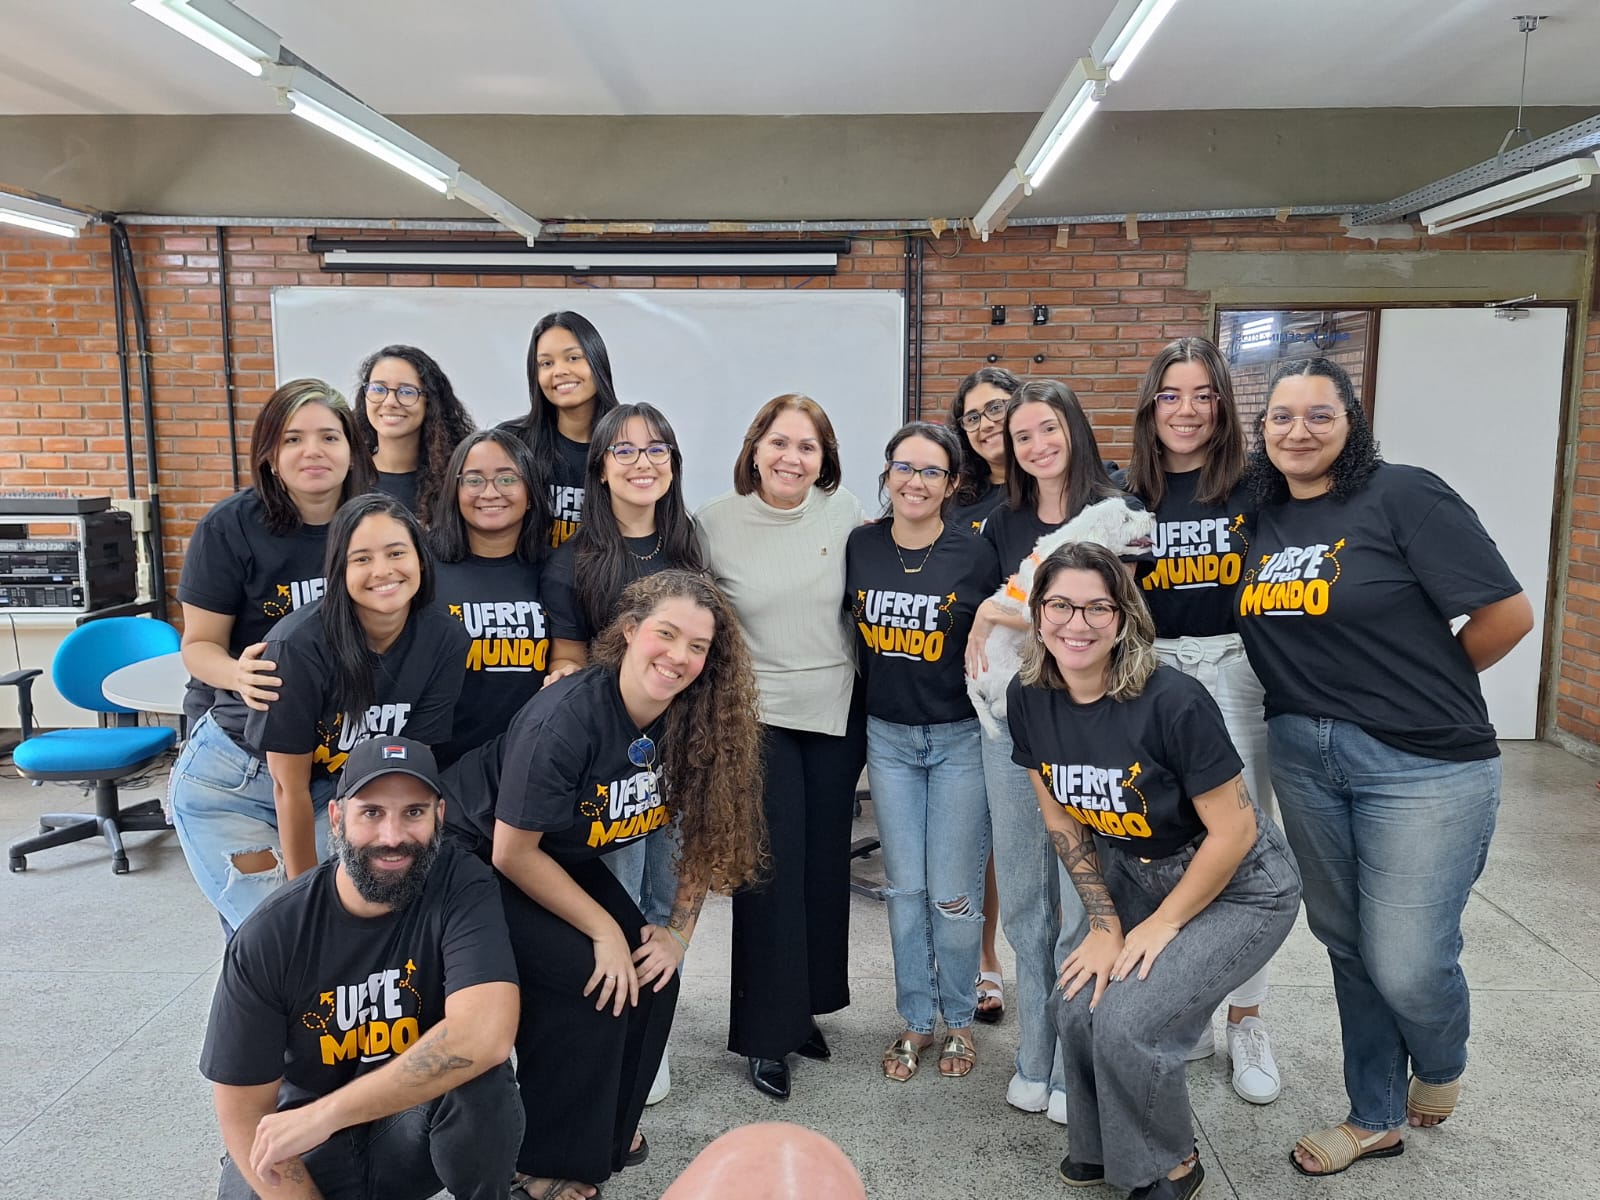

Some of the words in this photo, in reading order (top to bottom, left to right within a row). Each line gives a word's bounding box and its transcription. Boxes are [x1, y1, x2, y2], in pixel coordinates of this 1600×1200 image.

[548, 484, 585, 517] UFR
[563, 509, 582, 521] PE
[1151, 517, 1230, 557] UFRPE
[1169, 543, 1211, 557] PELO
[1142, 552, 1241, 590] MUNDO
[865, 589, 941, 631] UFRPE
[1240, 578, 1329, 616] MUNDO
[463, 601, 545, 638] UFRPE
[485, 626, 529, 639] PELO
[880, 614, 920, 629] PELO
[858, 622, 944, 662] MUNDO
[1051, 763, 1128, 813] UFRPE
[1069, 795, 1111, 811] PELO
